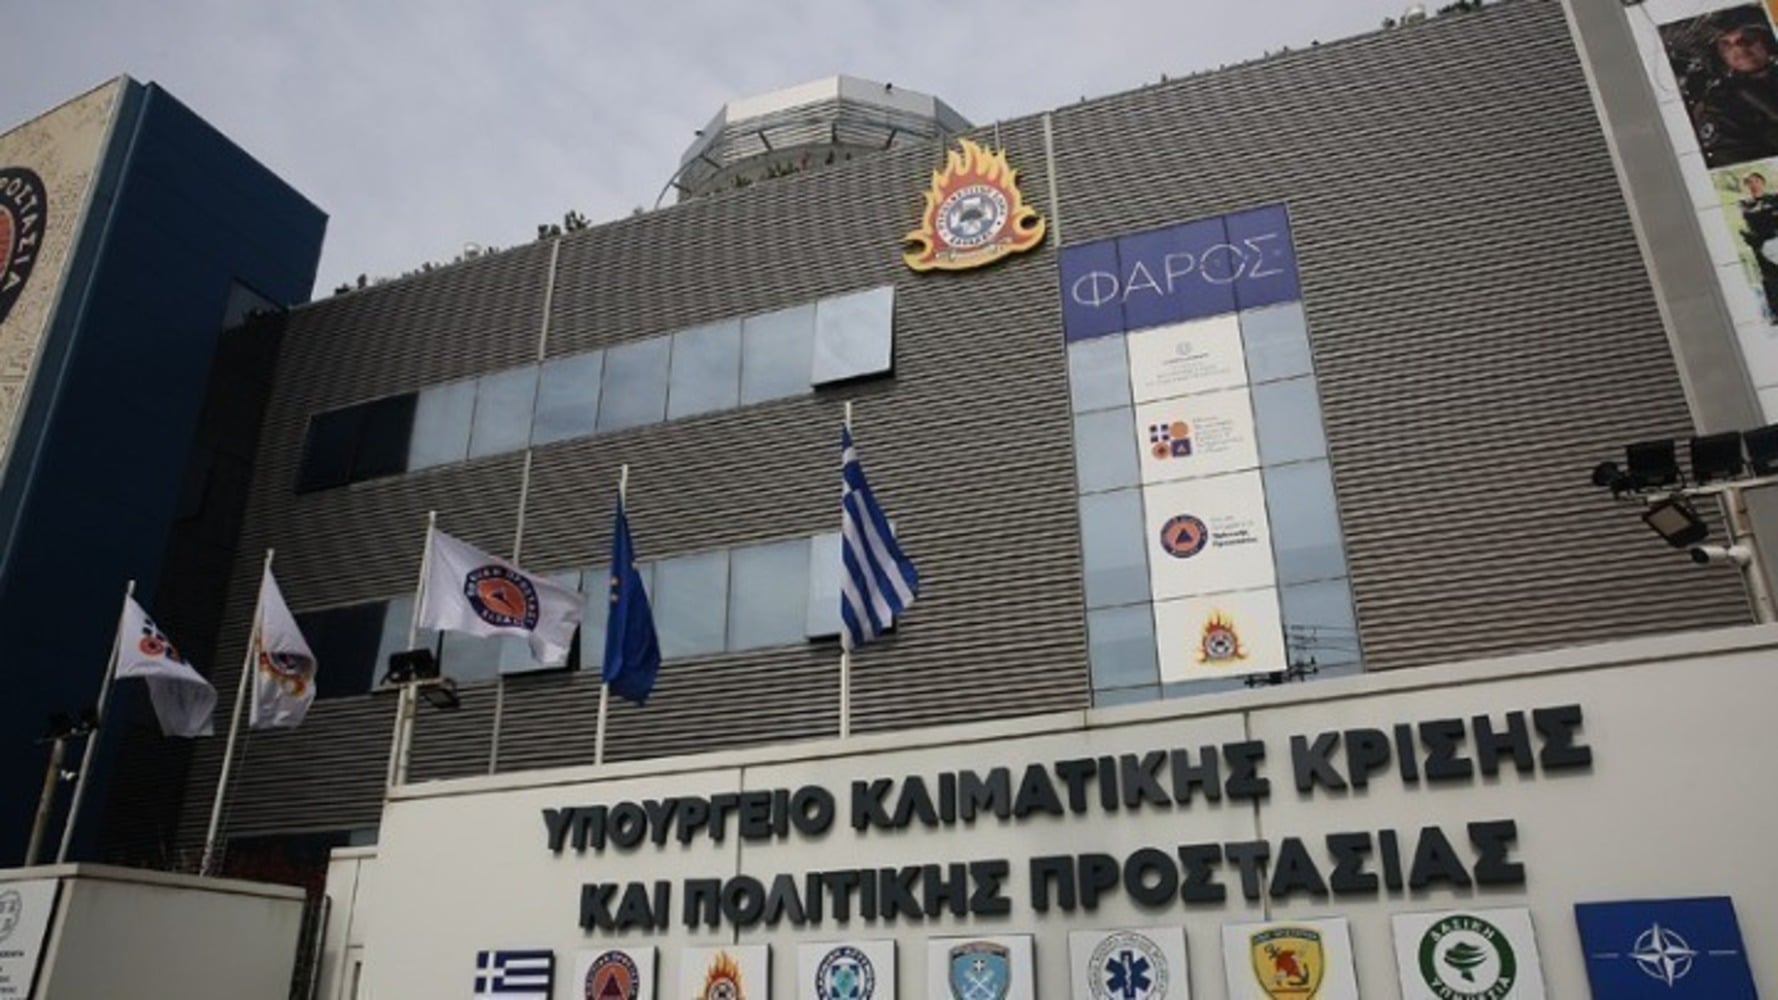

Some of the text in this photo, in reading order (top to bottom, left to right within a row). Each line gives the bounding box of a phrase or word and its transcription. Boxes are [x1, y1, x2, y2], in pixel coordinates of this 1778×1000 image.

[1072, 233, 1284, 306] ΦΑΡΟΣ
[542, 704, 1594, 851] ΥΠΟΥΡΓΕΙΟ ΚΛΙΜΑΤΙΚΗΣ ΚΡΙΣΗΣ
[579, 820, 1526, 931] ΚΑΙ ΠΟΛΙΤΙΚΗΣ ΠΡΟΣΤΑΣΙΑΣ
[1429, 918, 1496, 942] ΔΑΣΙΚΗ
